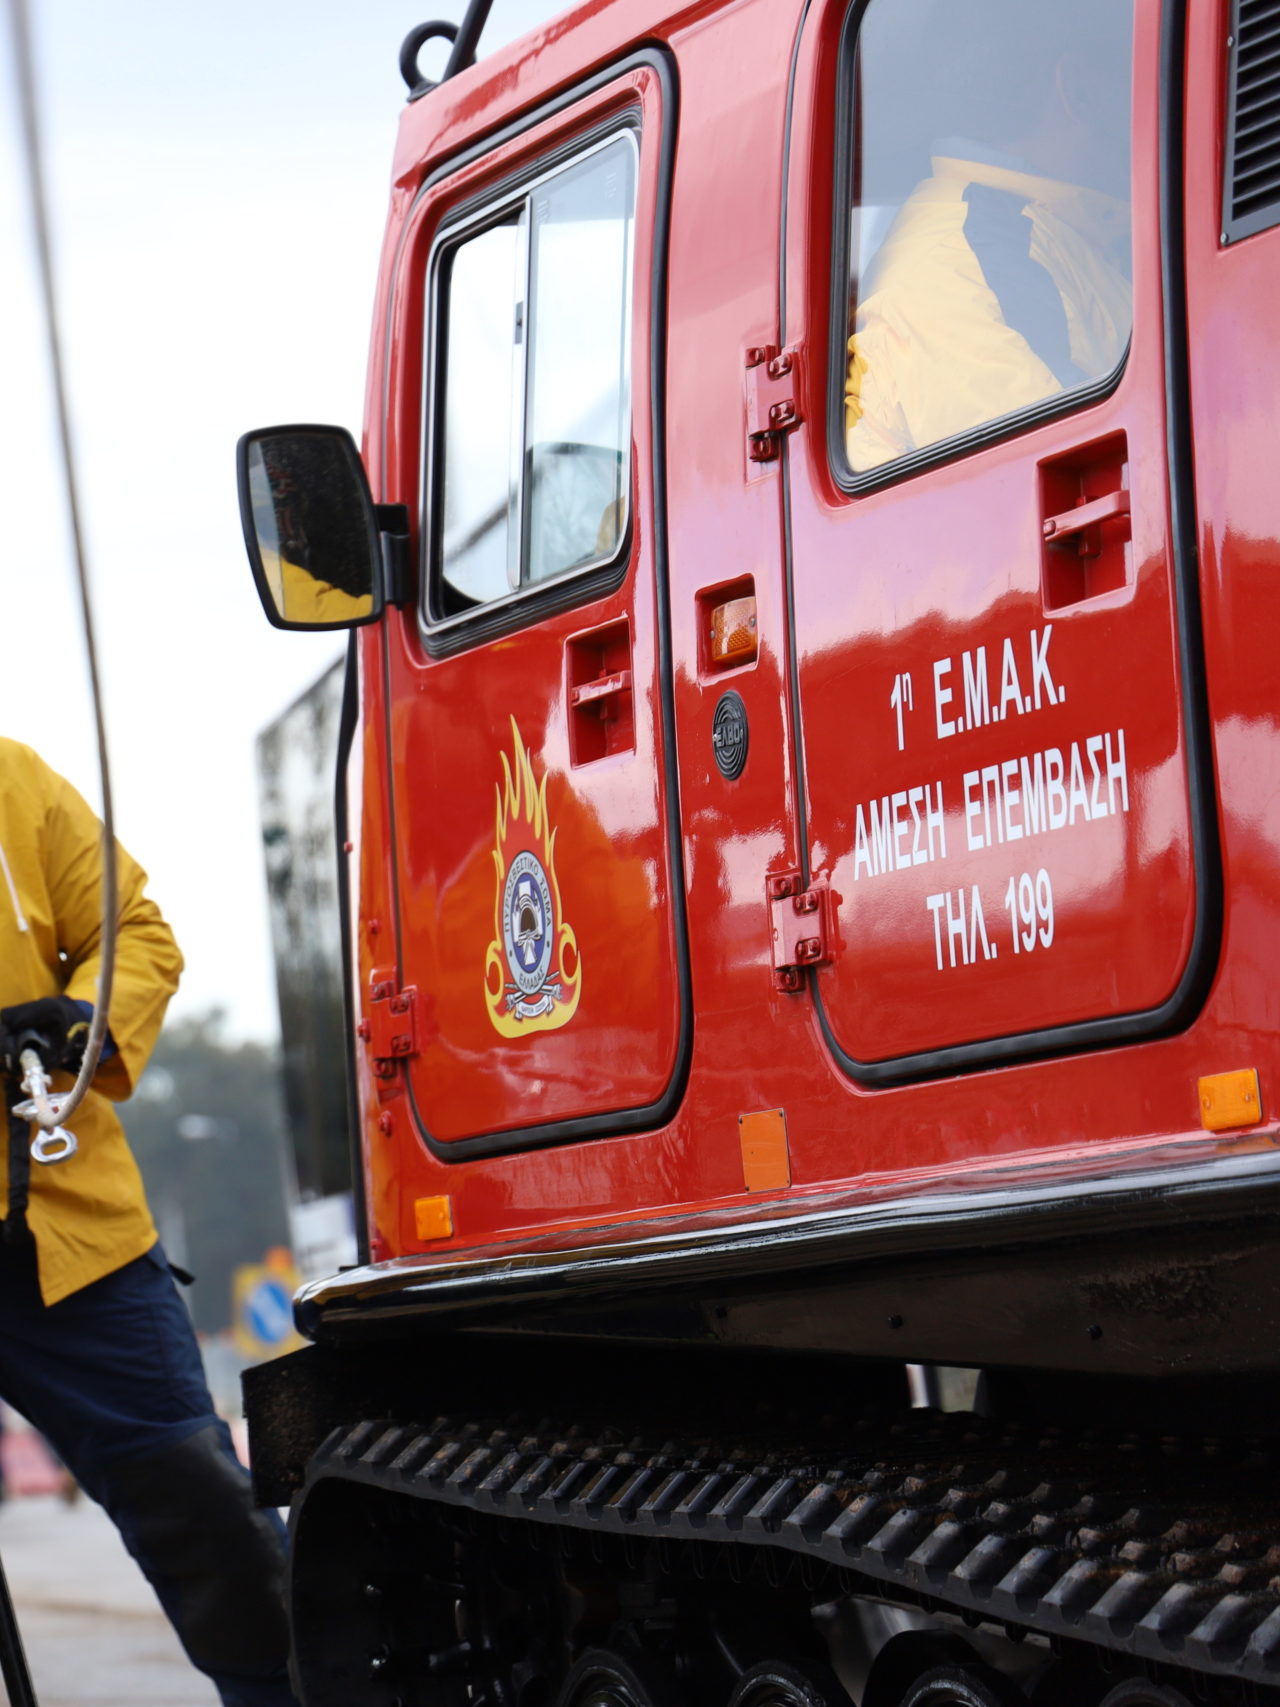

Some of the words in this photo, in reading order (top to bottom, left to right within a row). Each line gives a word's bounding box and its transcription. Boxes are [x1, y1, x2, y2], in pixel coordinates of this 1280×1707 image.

[933, 624, 1065, 739] Ε.Μ.Α.Κ.
[854, 781, 946, 880] ΑΜΕΣΗ
[963, 729, 1129, 851] ΕΠΕΜΒΑΣΗ
[926, 885, 997, 970] ΤΗΛ.
[1004, 868, 1054, 953] 199
